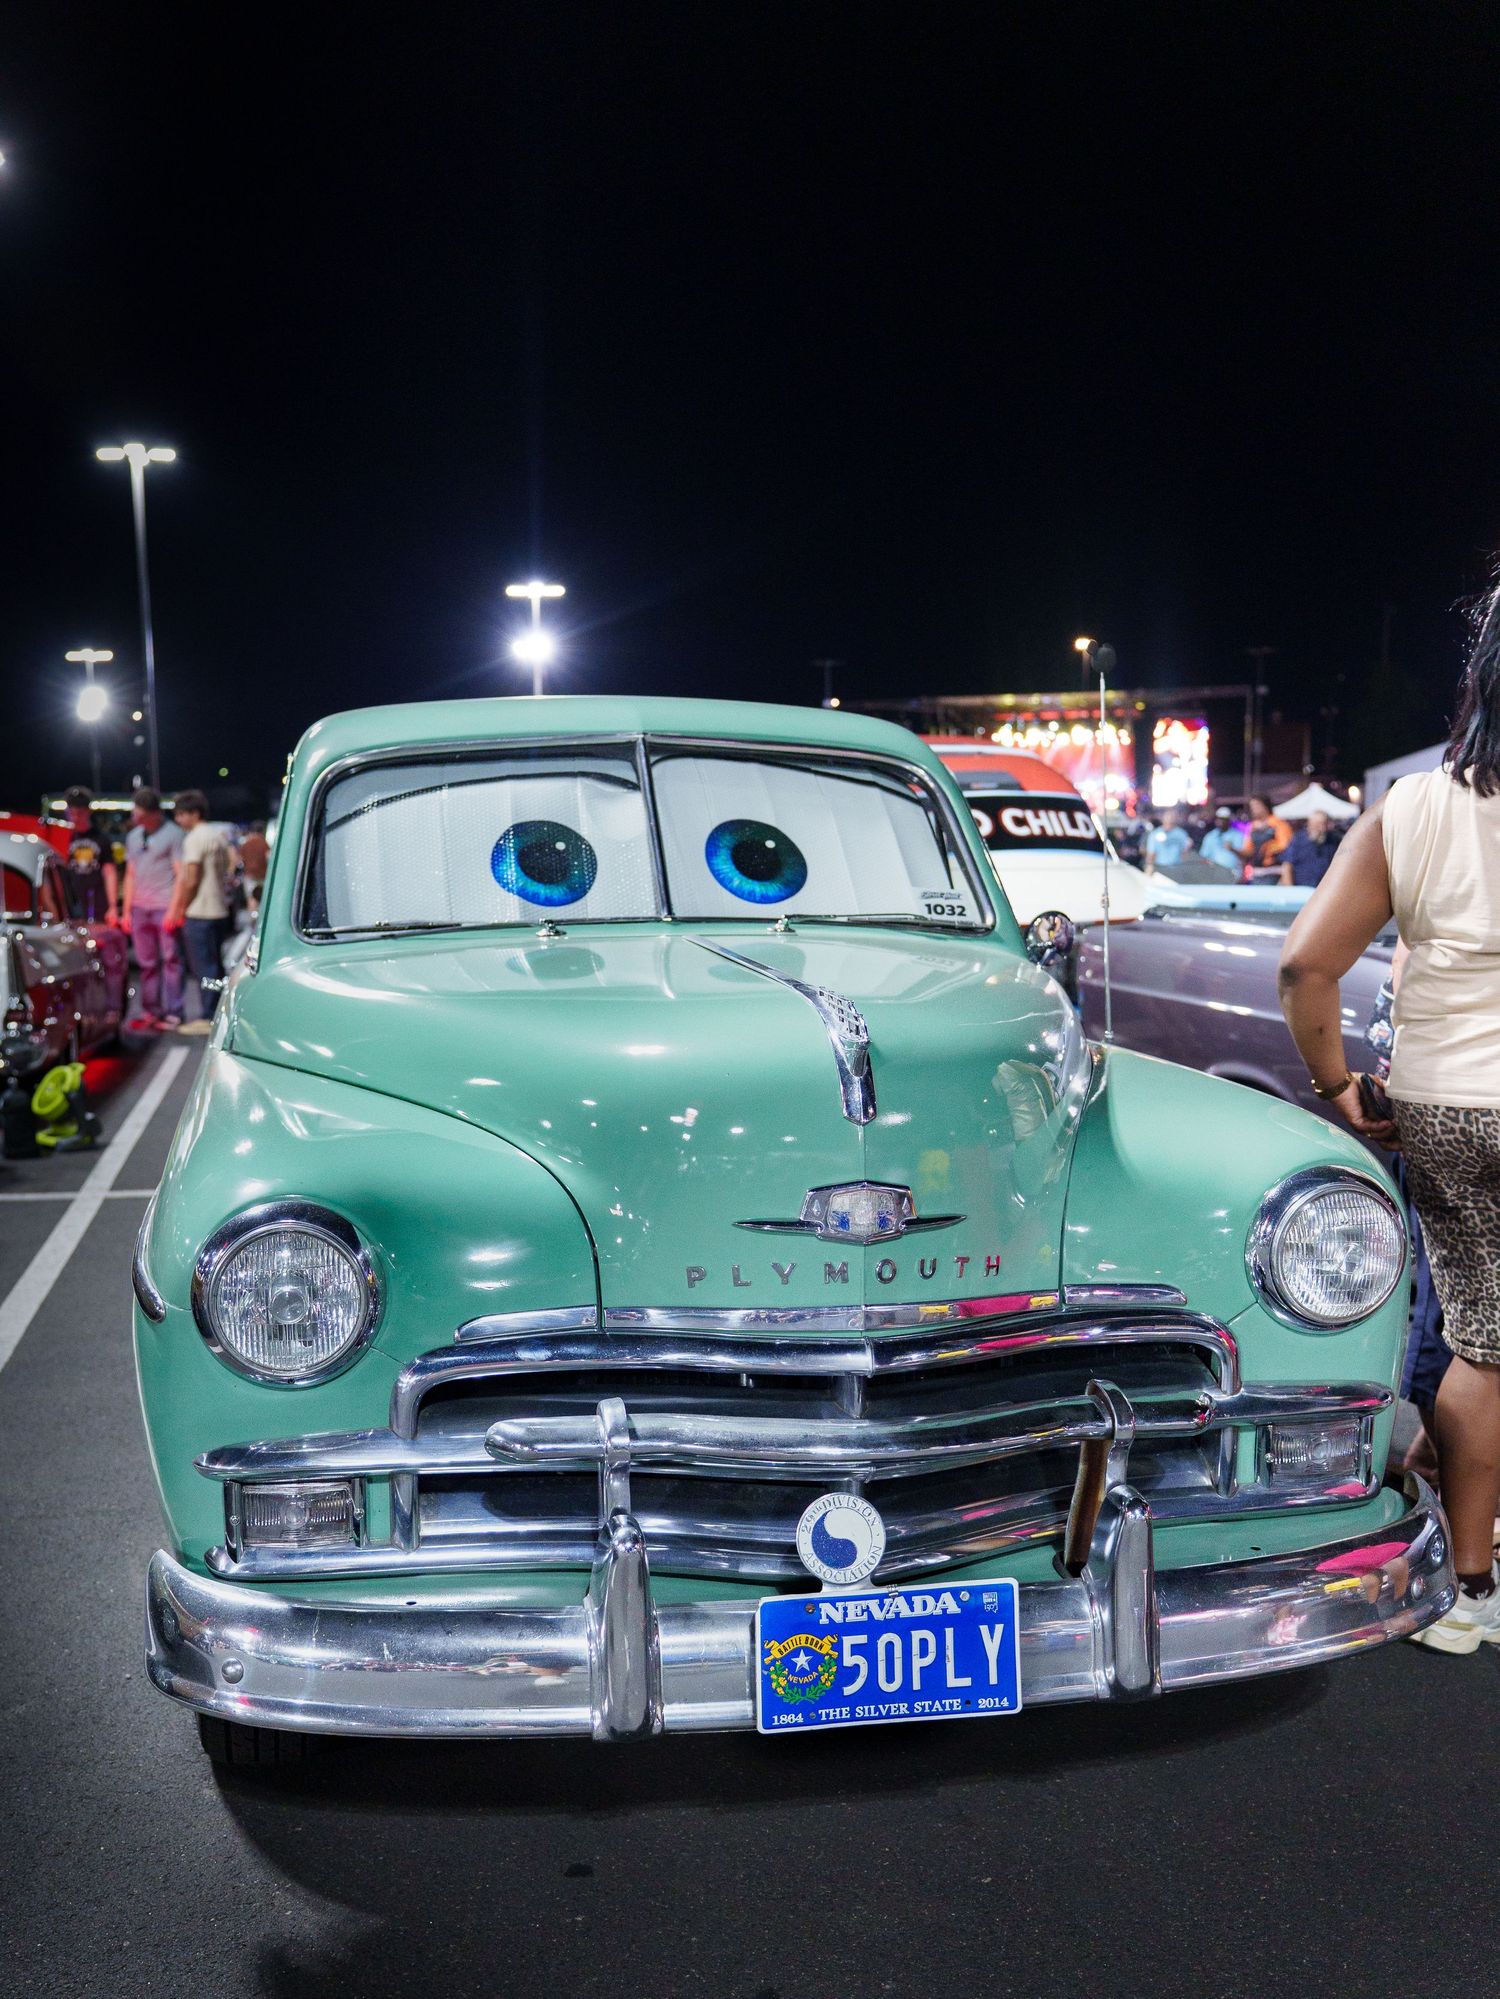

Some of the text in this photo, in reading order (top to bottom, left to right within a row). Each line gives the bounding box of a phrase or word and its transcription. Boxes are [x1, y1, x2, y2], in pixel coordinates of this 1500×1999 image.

[1001, 807, 1097, 839] CHILD
[925, 903, 966, 917] 1032
[686, 1255, 1001, 1289] PLYMOUTH
[822, 1495, 881, 1527] DIVISION
[802, 1545, 882, 1582] ASSOCIATION
[819, 1591, 961, 1624] NEVADA
[777, 1636, 825, 1656] BATTLE BORN
[842, 1624, 1004, 1696] 50PLY
[788, 1671, 819, 1684] NEVADA
[772, 1697, 1010, 1726] 1864 THE SILVER STATE 2014
